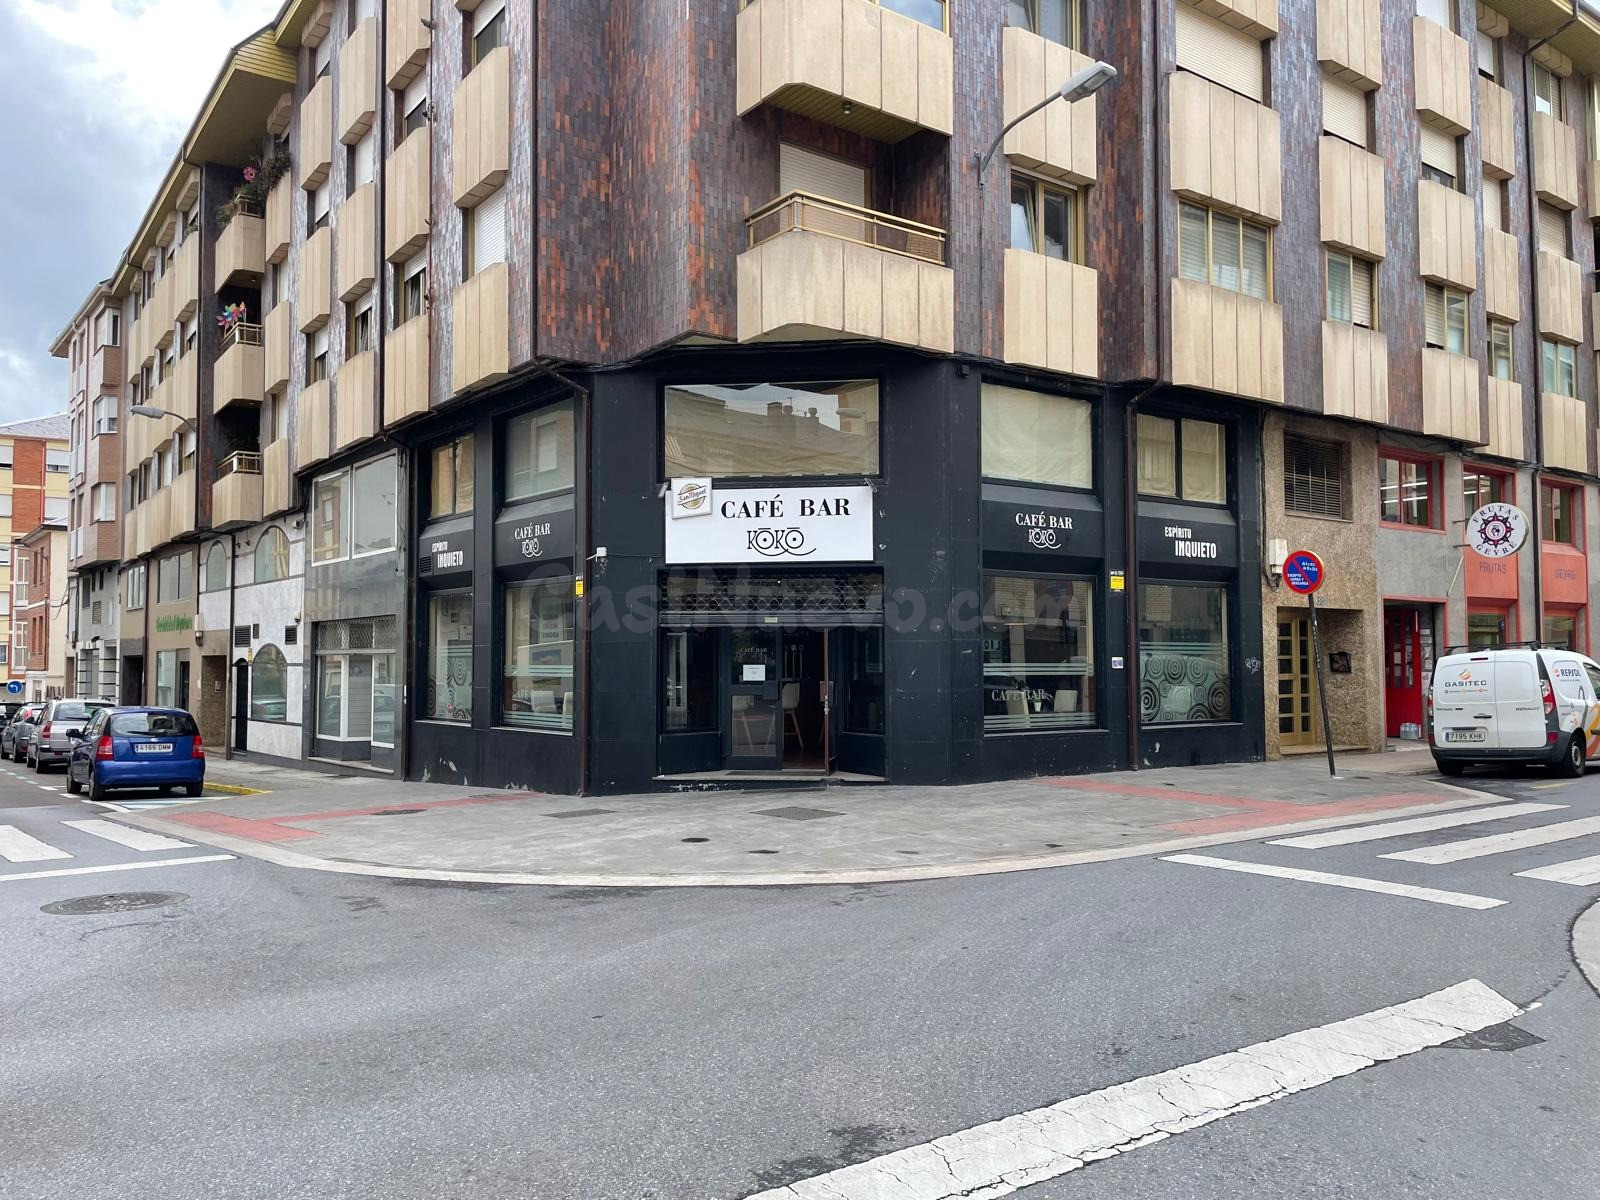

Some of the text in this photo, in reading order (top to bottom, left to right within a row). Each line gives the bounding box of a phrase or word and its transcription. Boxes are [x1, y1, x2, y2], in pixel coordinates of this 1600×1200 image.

[721, 494, 851, 518] CAFÉ BAR
[1015, 511, 1073, 529] CAFÉ BAR
[1473, 505, 1519, 523] FRUTAS
[514, 522, 551, 540] CAFÉ BAR
[1165, 525, 1191, 539] ESPÍRITU
[1175, 540, 1217, 559] INQUIETO
[1476, 541, 1517, 556] GEYRE
[437, 550, 464, 568] INQUIETO
[1480, 561, 1507, 574] FRUTAS
[1554, 568, 1577, 579] GEYRE
[1560, 668, 1582, 677] REPSOL
[1444, 680, 1487, 688] GASITEC
[1450, 732, 1483, 740] 7195 KHK
